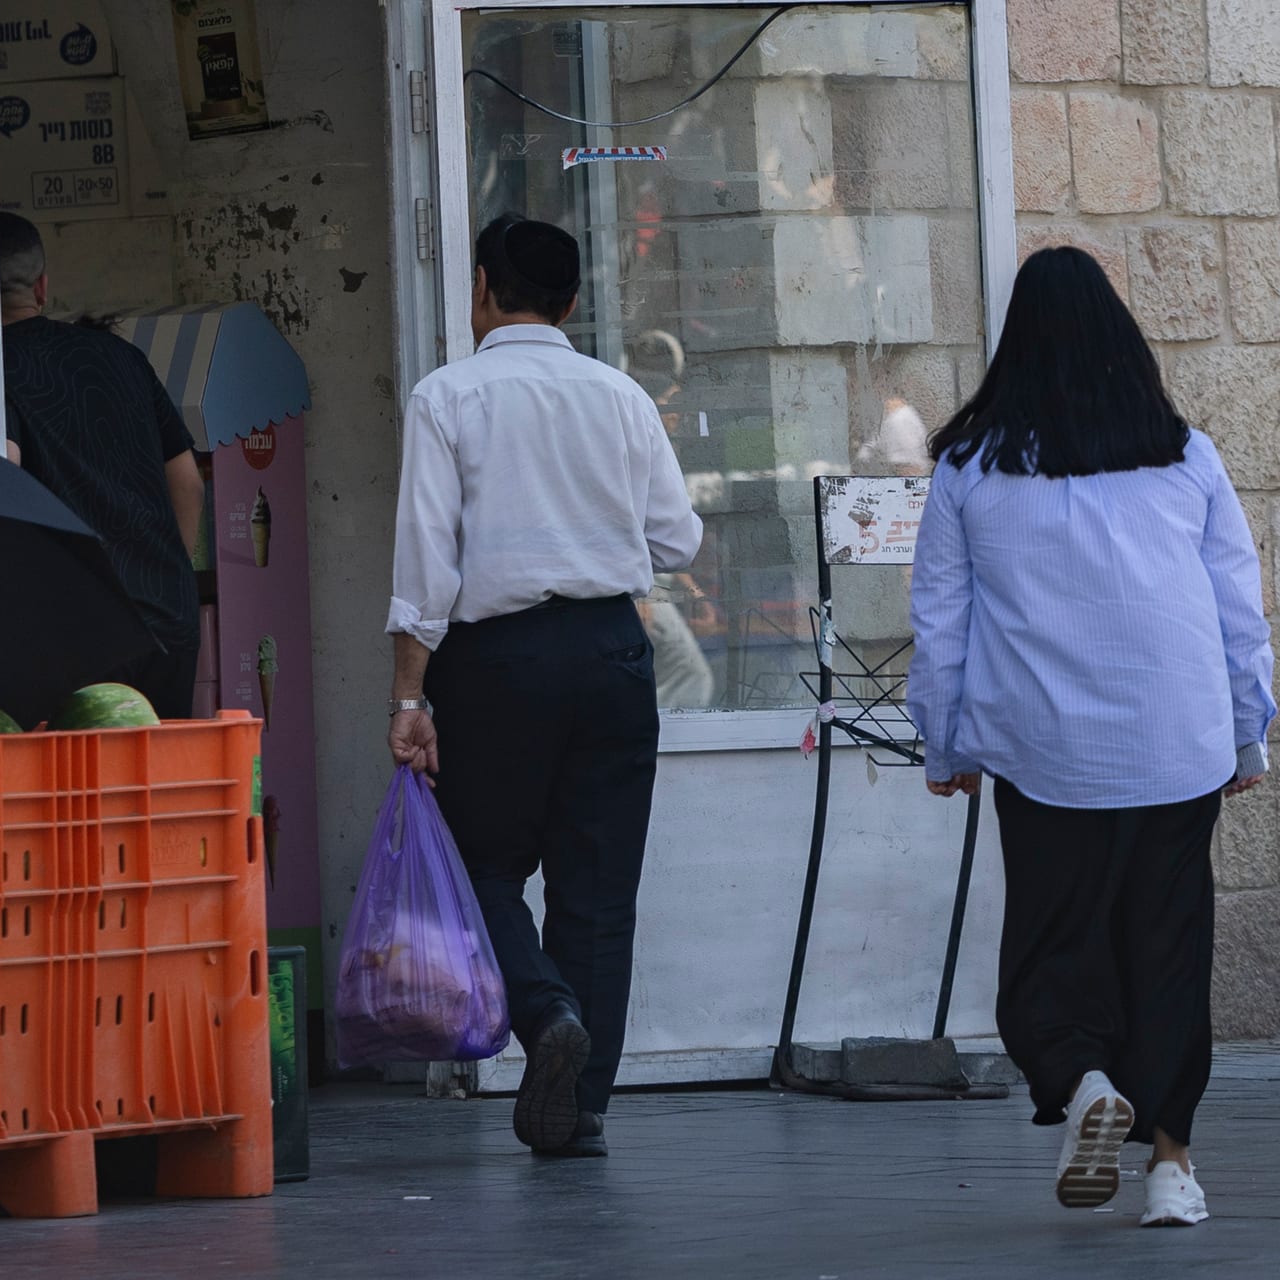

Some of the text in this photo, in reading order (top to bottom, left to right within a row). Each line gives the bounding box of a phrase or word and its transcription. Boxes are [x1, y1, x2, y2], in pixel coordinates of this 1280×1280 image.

[69, 119, 113, 140] כוסות
[93, 144, 115, 164] 8B
[43, 177, 64, 194] 20
[880, 545, 913, 556] וערבי חג
